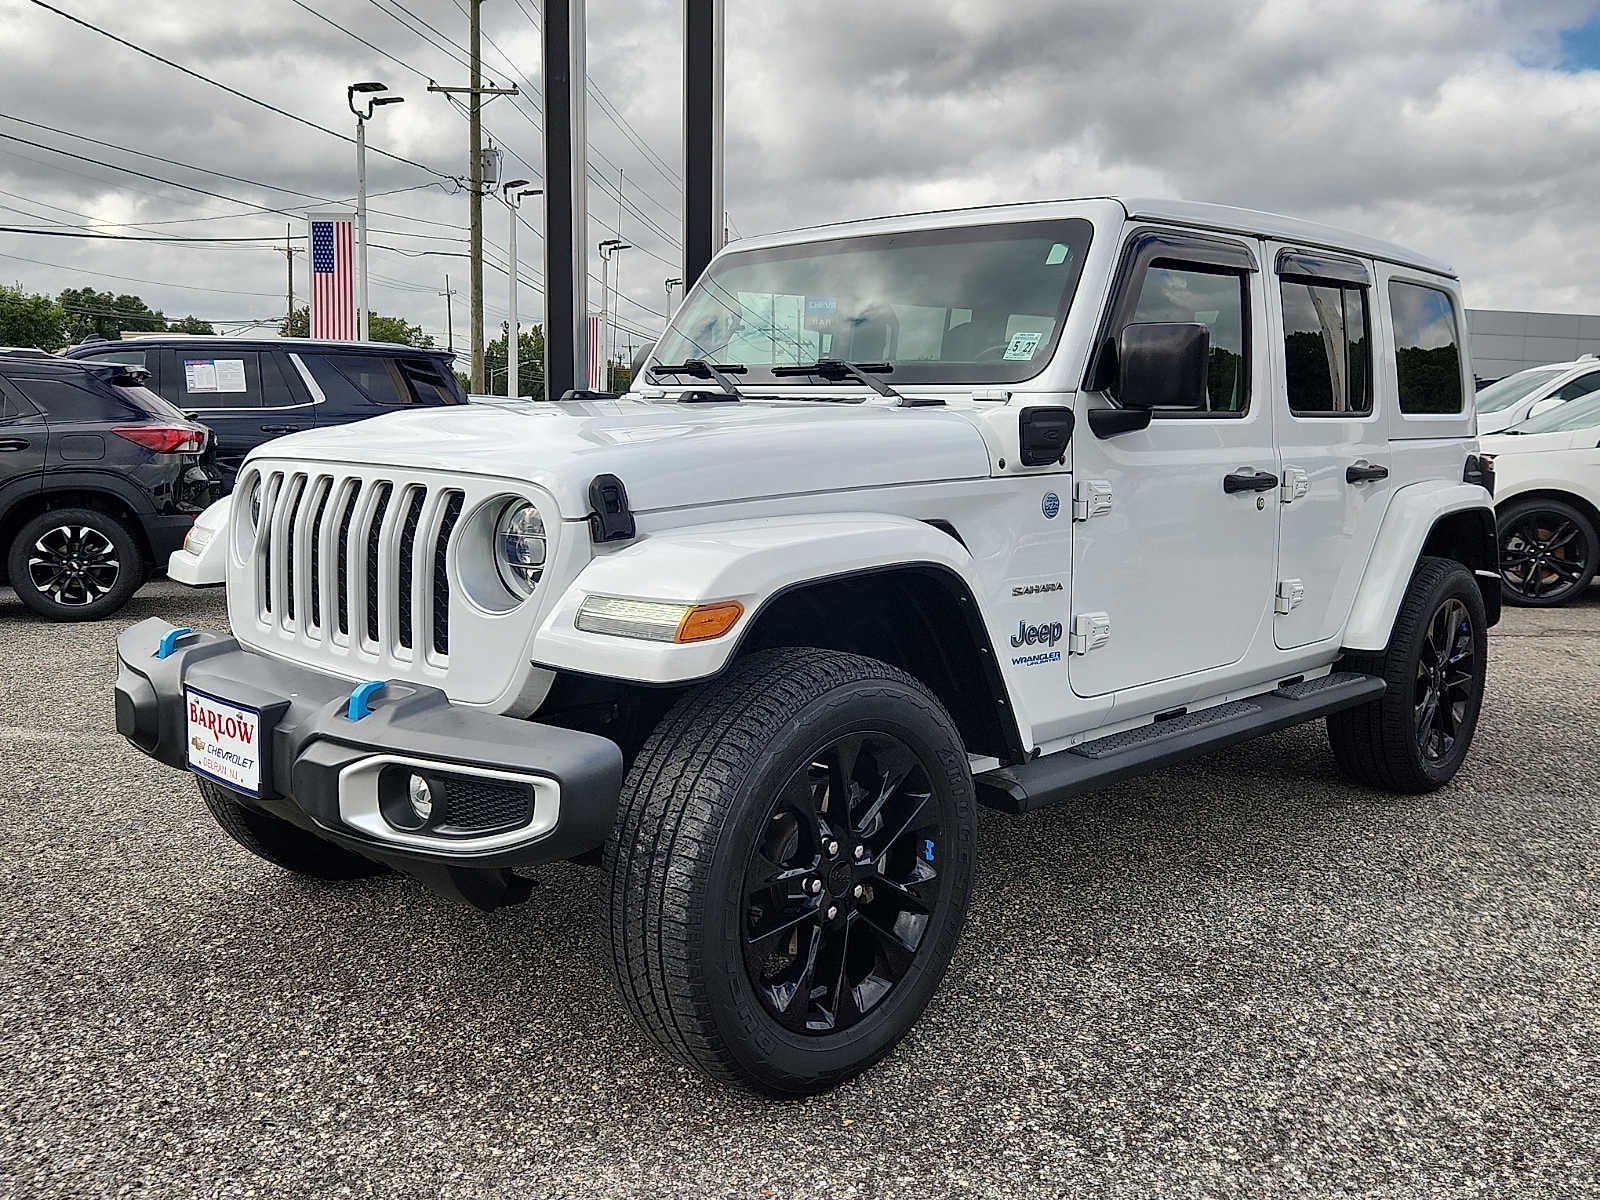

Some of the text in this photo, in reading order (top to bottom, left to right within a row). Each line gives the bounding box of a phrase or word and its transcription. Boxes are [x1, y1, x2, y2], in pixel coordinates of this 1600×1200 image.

[1013, 341, 1036, 352] 5 27
[1012, 582, 1063, 596] SAHARA
[1010, 620, 1063, 648] Jeep
[1012, 651, 1060, 665] WRANGLER
[190, 702, 254, 744] BARLOW
[207, 743, 255, 769] CHEVROLET
